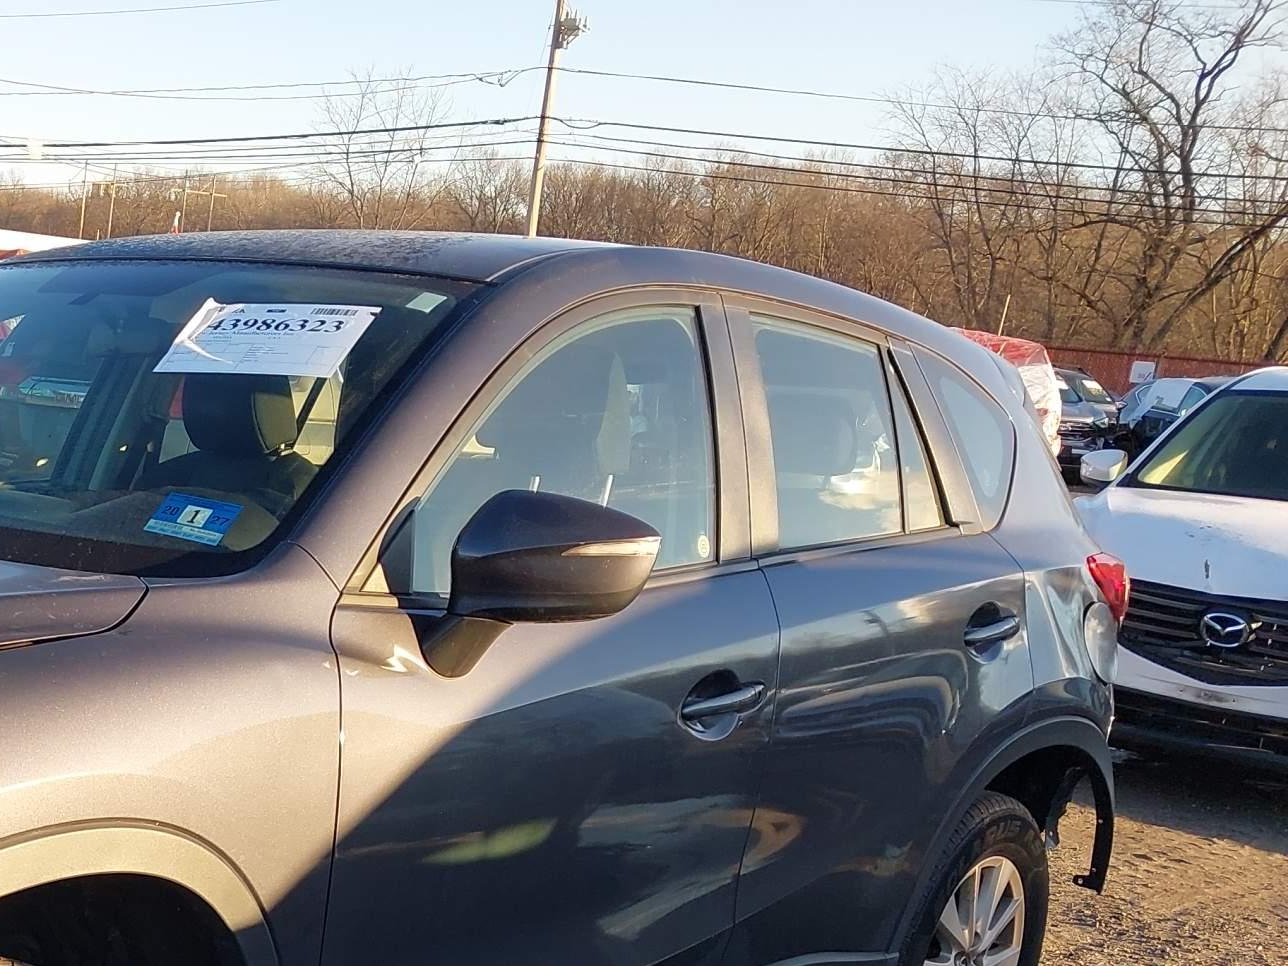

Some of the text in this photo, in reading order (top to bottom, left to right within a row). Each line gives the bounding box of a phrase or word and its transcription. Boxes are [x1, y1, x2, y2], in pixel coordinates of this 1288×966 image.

[208, 317, 345, 333] 43986323
[161, 506, 230, 526] 20 1 27
